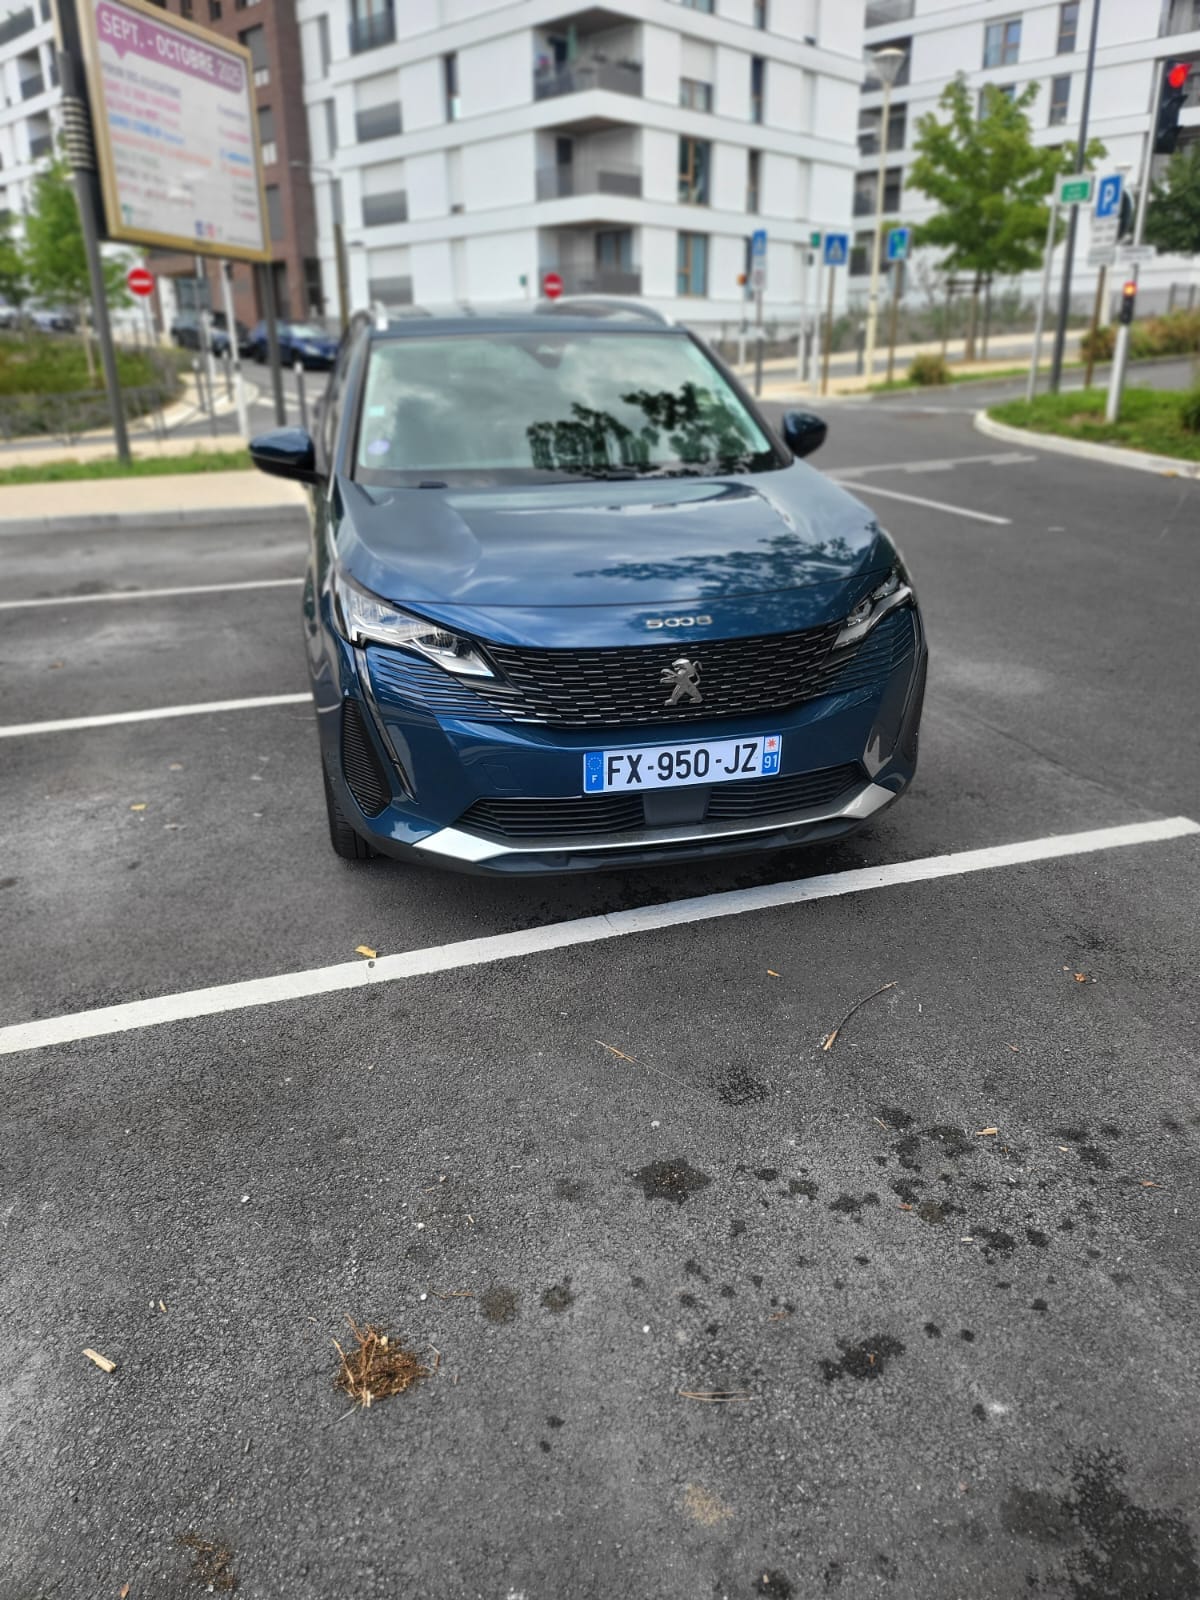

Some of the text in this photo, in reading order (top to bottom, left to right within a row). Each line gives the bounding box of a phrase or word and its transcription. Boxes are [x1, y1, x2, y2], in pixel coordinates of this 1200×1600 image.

[101, 11, 145, 48] SEPT.
[156, 33, 215, 77] OCTOBRE
[607, 743, 758, 786] FX-950-JZ
[763, 755, 778, 769] 91
[591, 775, 598, 784] F
